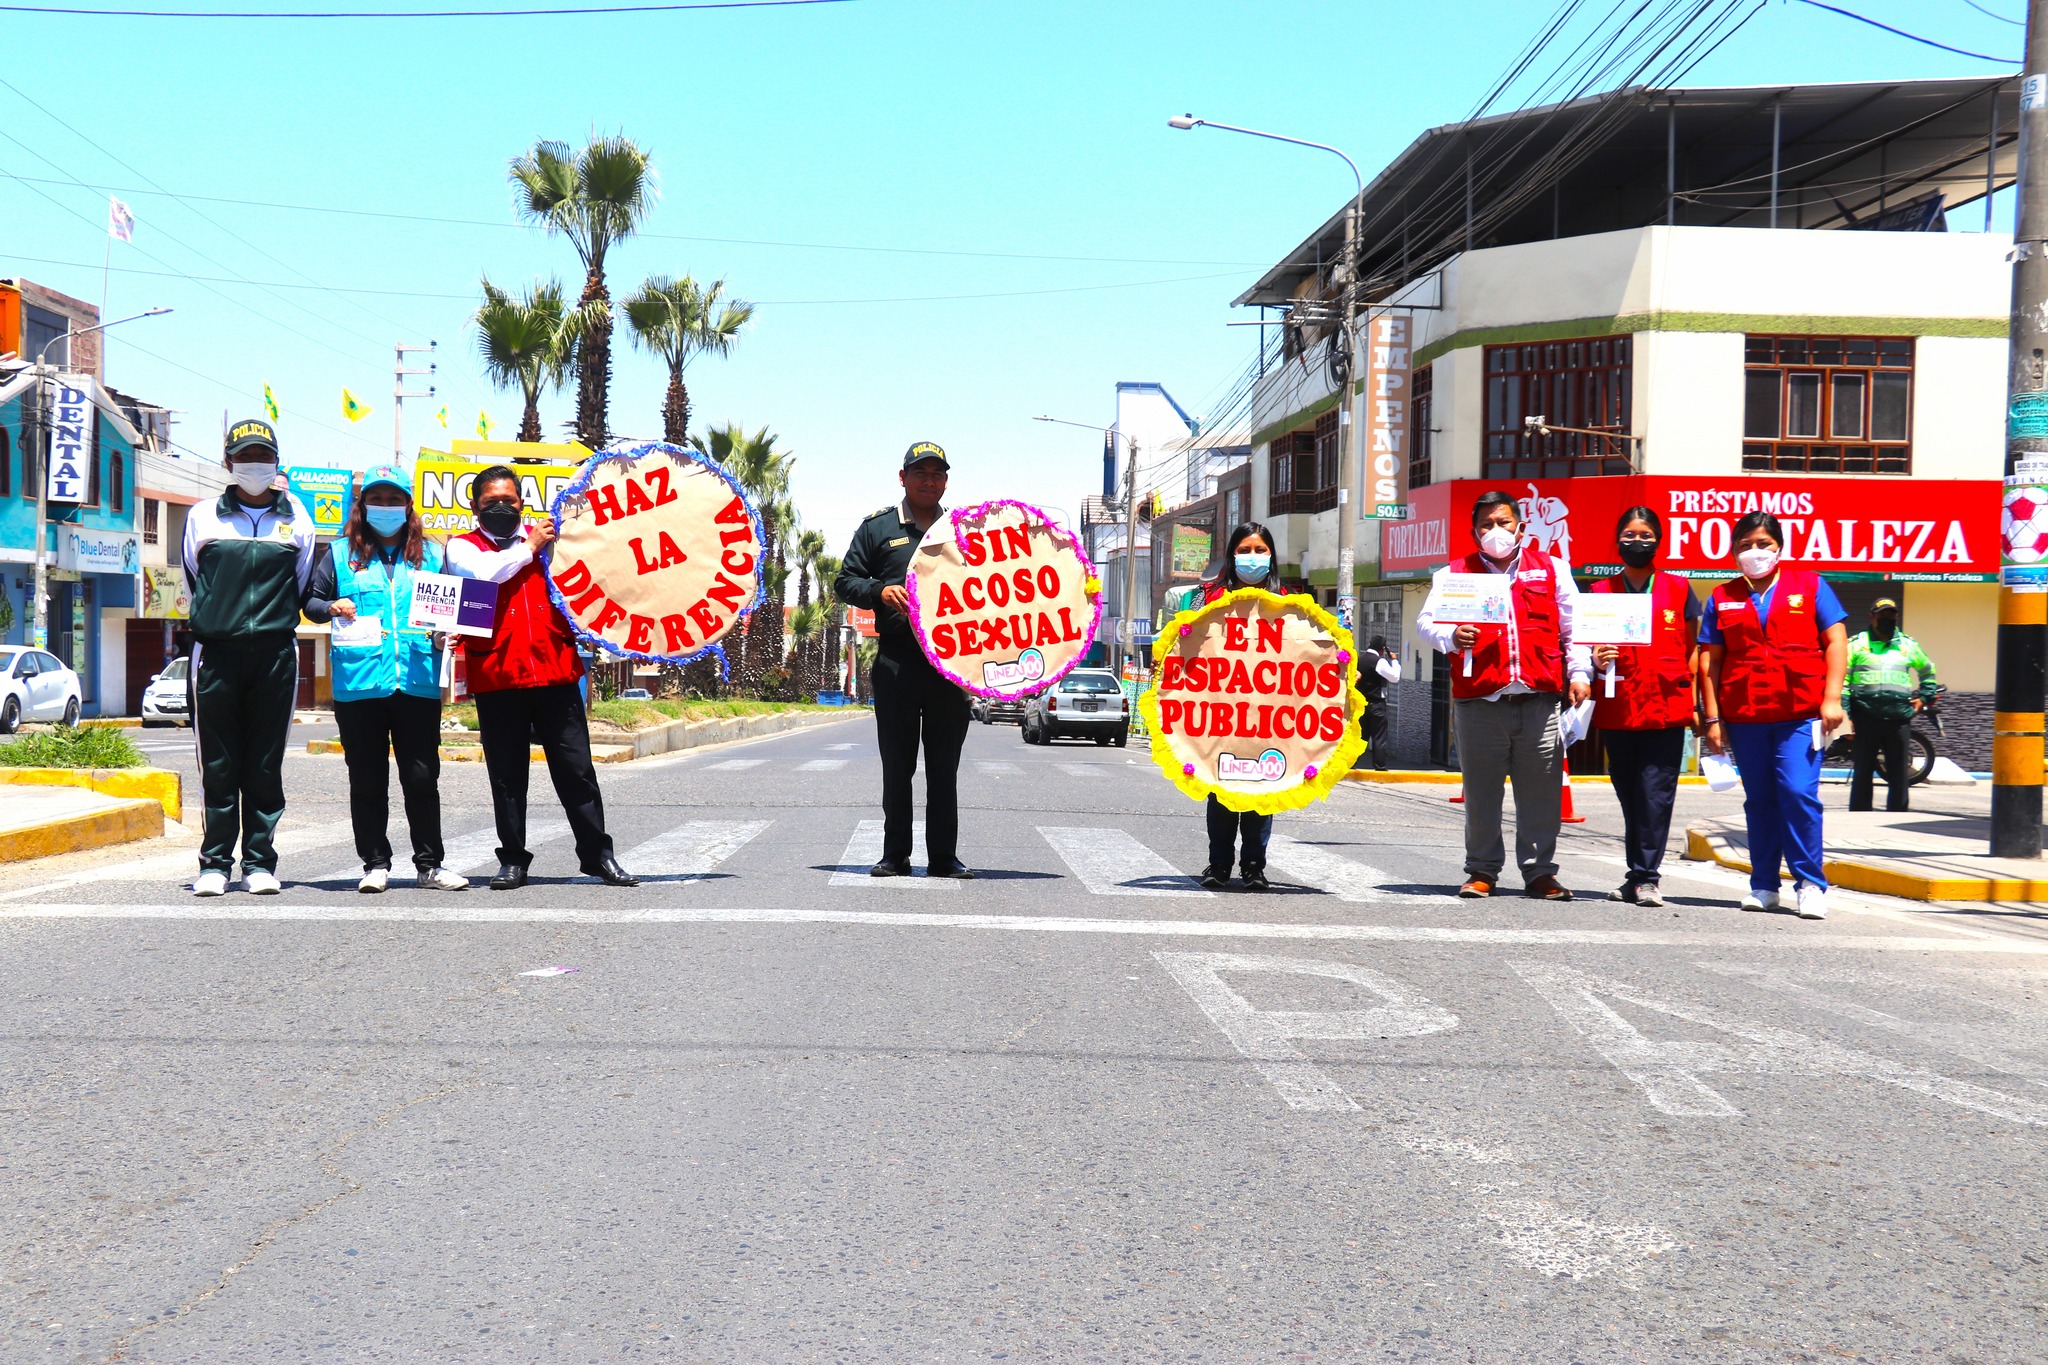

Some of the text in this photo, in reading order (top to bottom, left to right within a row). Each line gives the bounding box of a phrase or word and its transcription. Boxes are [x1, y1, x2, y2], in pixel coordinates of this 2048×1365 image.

[1373, 319, 1408, 502] EMPEÑOS
[53, 388, 86, 498] DENTAL
[232, 423, 273, 442] POLICIA
[912, 443, 945, 460] POLICIA
[585, 466, 678, 526] HAZ
[1377, 505, 1407, 518] SOAT
[1668, 488, 1814, 515] PRÉSTAMOS
[80, 540, 120, 557] Blue Dental
[628, 531, 688, 575] LA
[965, 523, 1032, 566] SIN
[1388, 518, 1447, 560] FORTALEZA
[1666, 517, 1974, 564] FOTALEZA
[417, 582, 456, 598] HAZ LA
[552, 496, 754, 653] DIFERENCIA
[936, 565, 1060, 617] ACOSO
[1891, 572, 1983, 582] Inversiones Fortaleza
[416, 594, 455, 606] DIFERENCIA
[932, 607, 1081, 659] SEXUAL
[1224, 617, 1285, 654] EN
[1161, 656, 1341, 698] ESPACIOS
[1160, 699, 1344, 742] PUBLICOS
